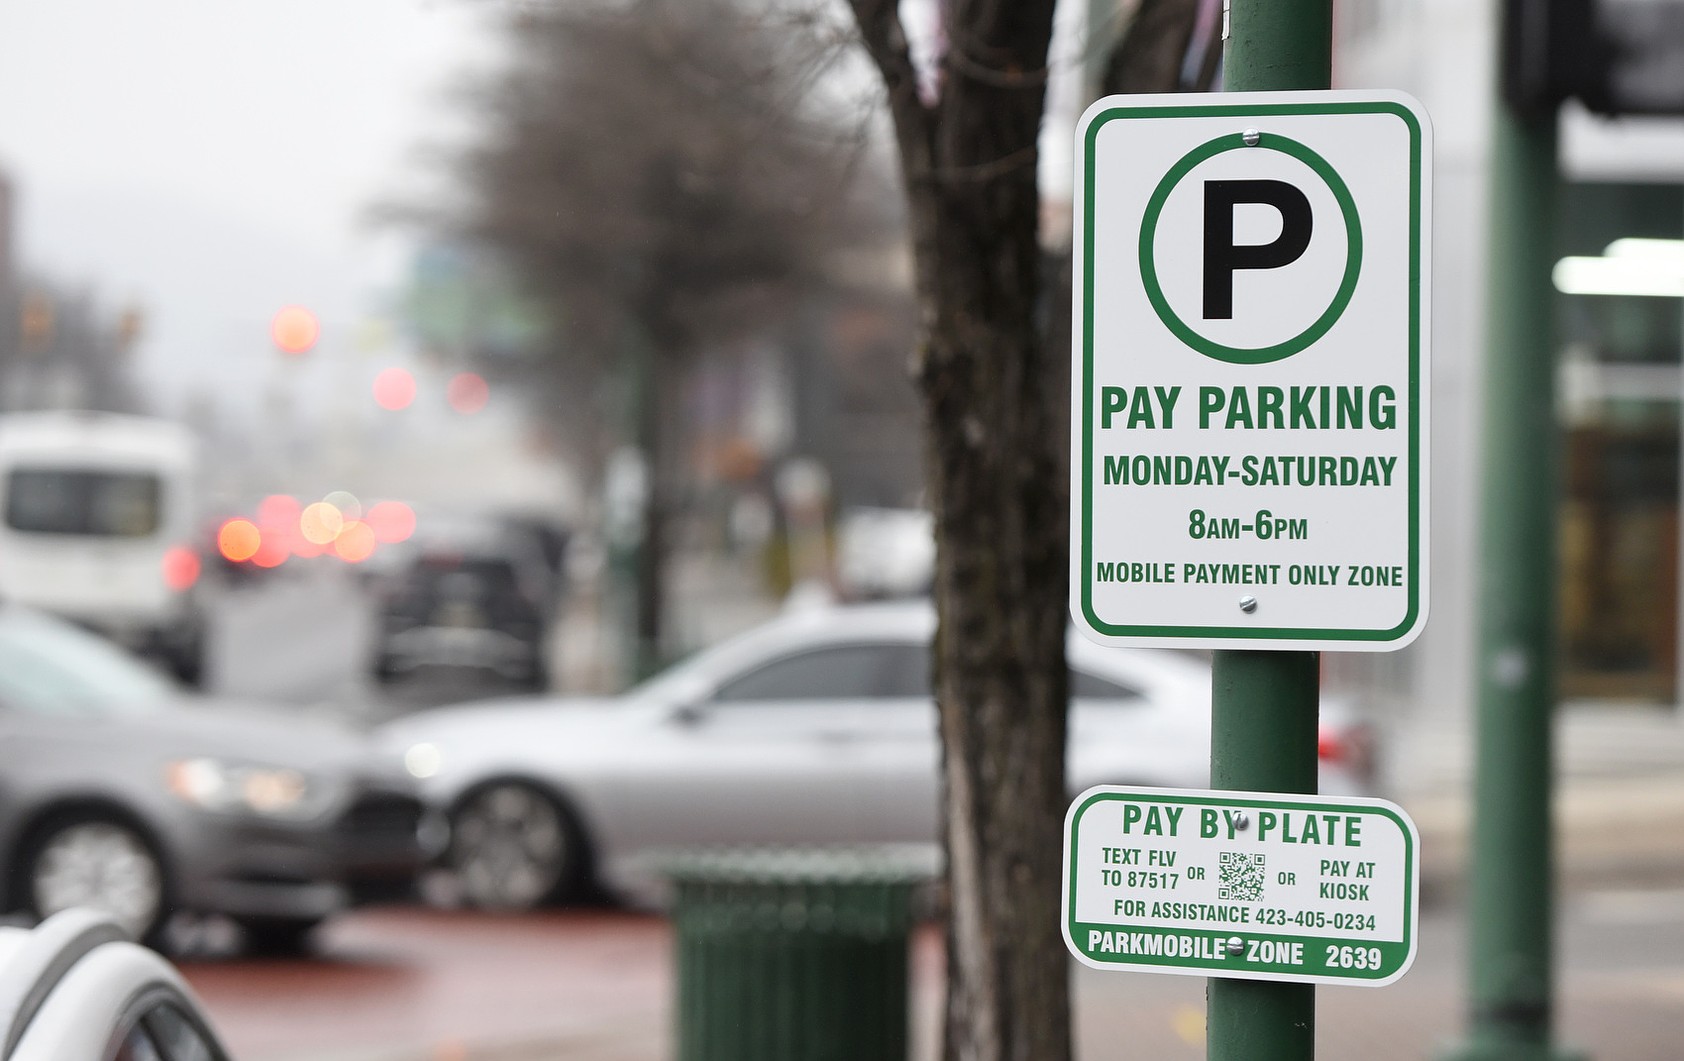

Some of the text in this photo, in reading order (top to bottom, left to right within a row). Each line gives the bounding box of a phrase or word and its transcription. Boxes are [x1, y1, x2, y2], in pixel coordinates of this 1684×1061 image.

[1203, 179, 1314, 320] P
[1101, 384, 1397, 430] PAY PARKING
[1103, 455, 1398, 487] MONDAY-SATURDAY
[1189, 509, 1308, 540] 8AM-6PM
[1096, 562, 1403, 587] MOBILE PAYMENT ONLY ZONE
[1123, 804, 1362, 847] PAY BY PLATE
[1102, 847, 1177, 867] TEXT FLV
[1320, 860, 1375, 879] PAY AT
[1101, 869, 1179, 890] TO 87517
[1187, 867, 1205, 880] OR
[1278, 872, 1296, 886] OR
[1319, 883, 1369, 901] KIOSK
[1114, 899, 1376, 931] FOR ASSISTANCE 423-405-0234
[1088, 930, 1382, 970] PARKMOBILE ZONE 2639
